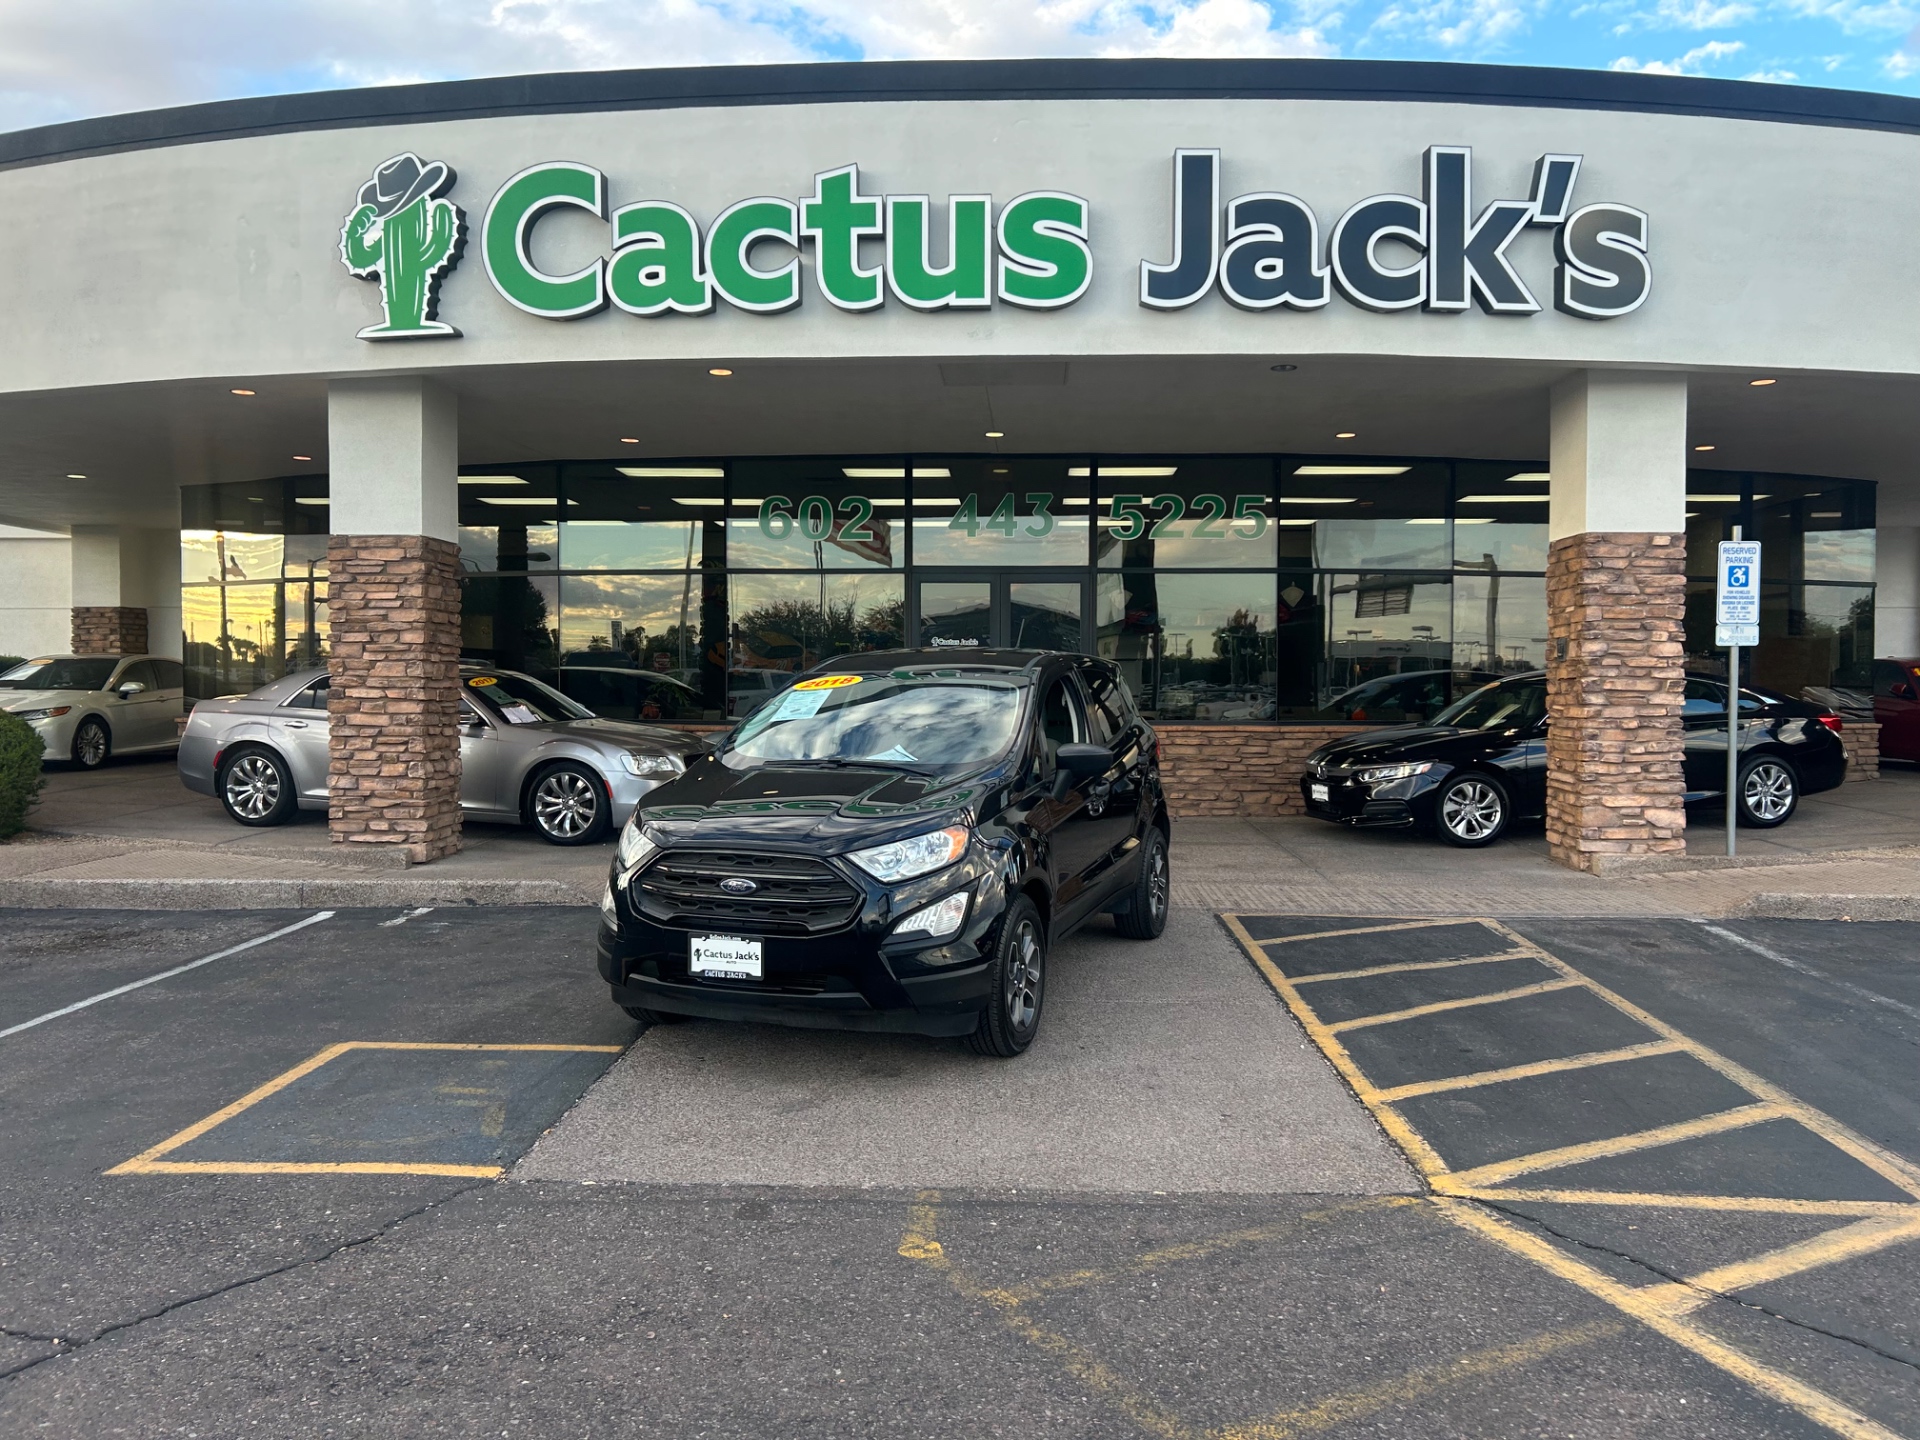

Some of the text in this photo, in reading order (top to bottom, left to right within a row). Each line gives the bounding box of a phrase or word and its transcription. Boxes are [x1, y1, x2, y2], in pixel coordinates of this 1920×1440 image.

[482, 145, 1653, 320] Cactus Jack's
[758, 492, 1269, 542] 602 443 5225
[1722, 546, 1757, 555] RESERVED
[1725, 556, 1754, 564] PARKING
[472, 677, 493, 686] 2017
[803, 676, 859, 689] 2018
[703, 948, 760, 961] Cactus Jack's
[704, 970, 725, 978] CACTUS
